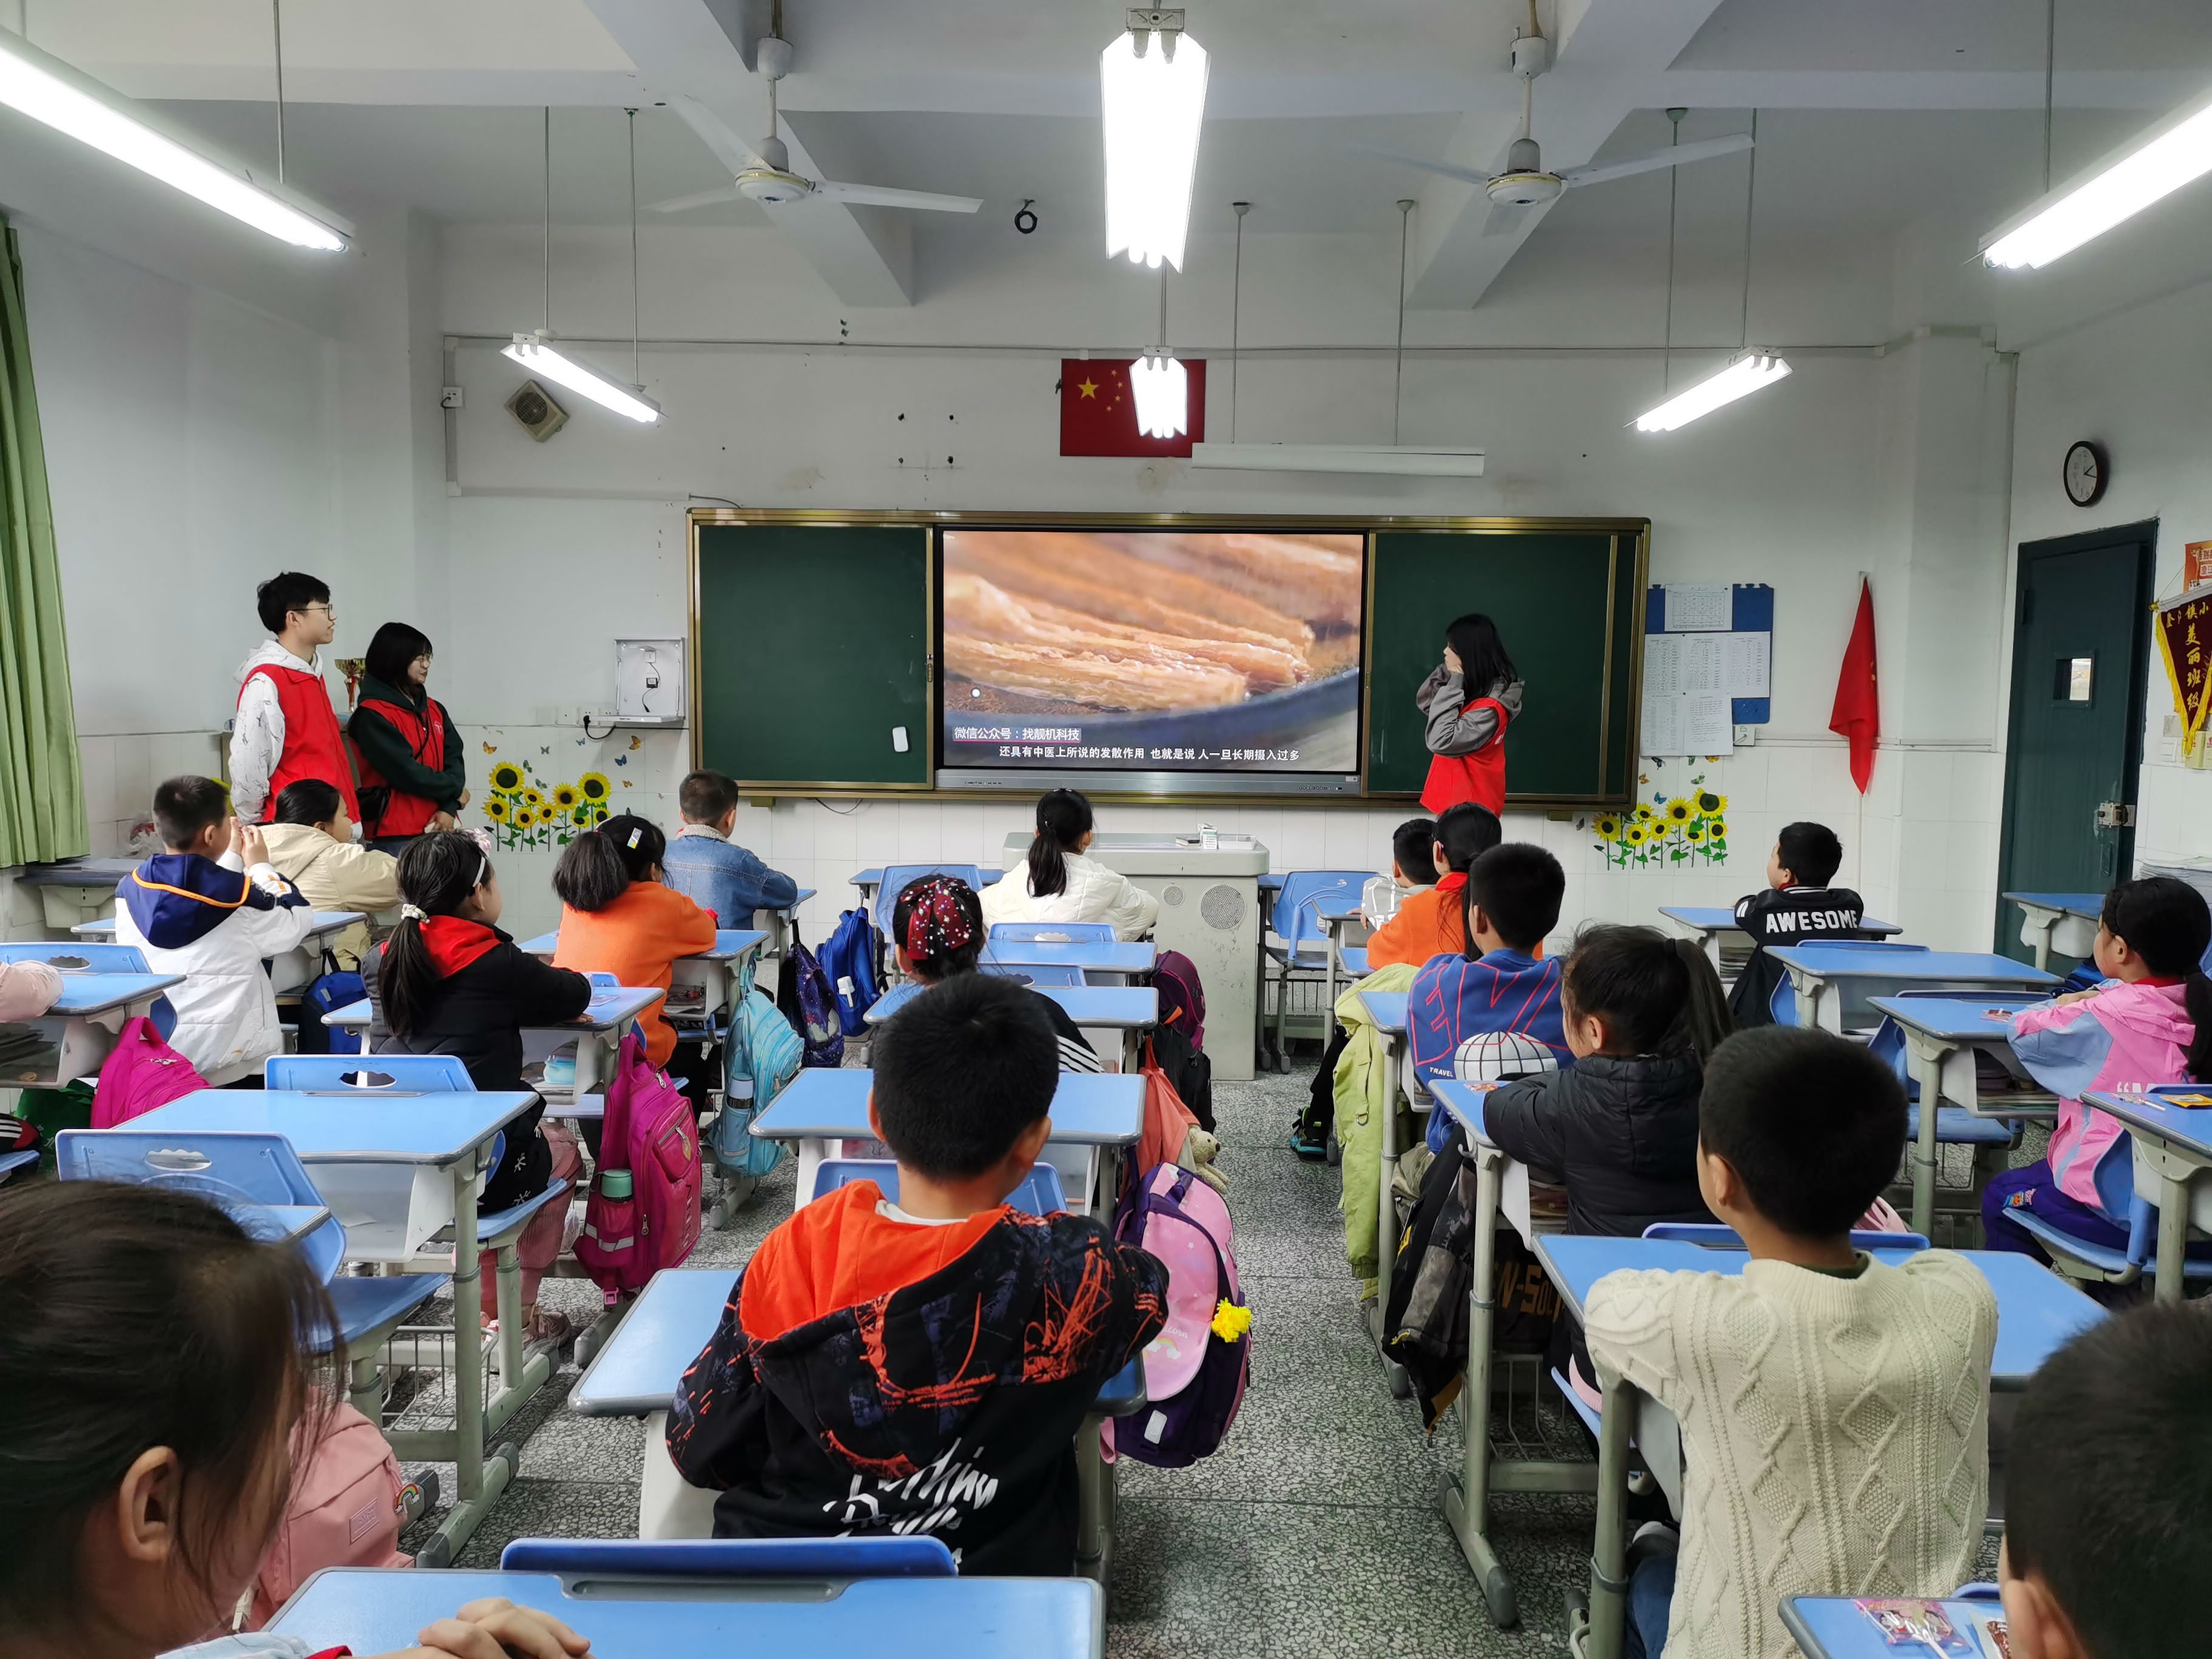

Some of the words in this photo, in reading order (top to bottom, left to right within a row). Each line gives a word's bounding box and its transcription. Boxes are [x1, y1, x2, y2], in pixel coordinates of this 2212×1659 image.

[2185, 623, 2200, 711] 美丽班级
[999, 746, 1145, 759] 还具有中医上所说的发散作用
[1150, 748, 1195, 760] 也就是说
[1198, 749, 1299, 762] 人一旦长期摄入过多
[1766, 910, 1857, 934] AWESOME
[1430, 1067, 1453, 1078] TRAVEL
